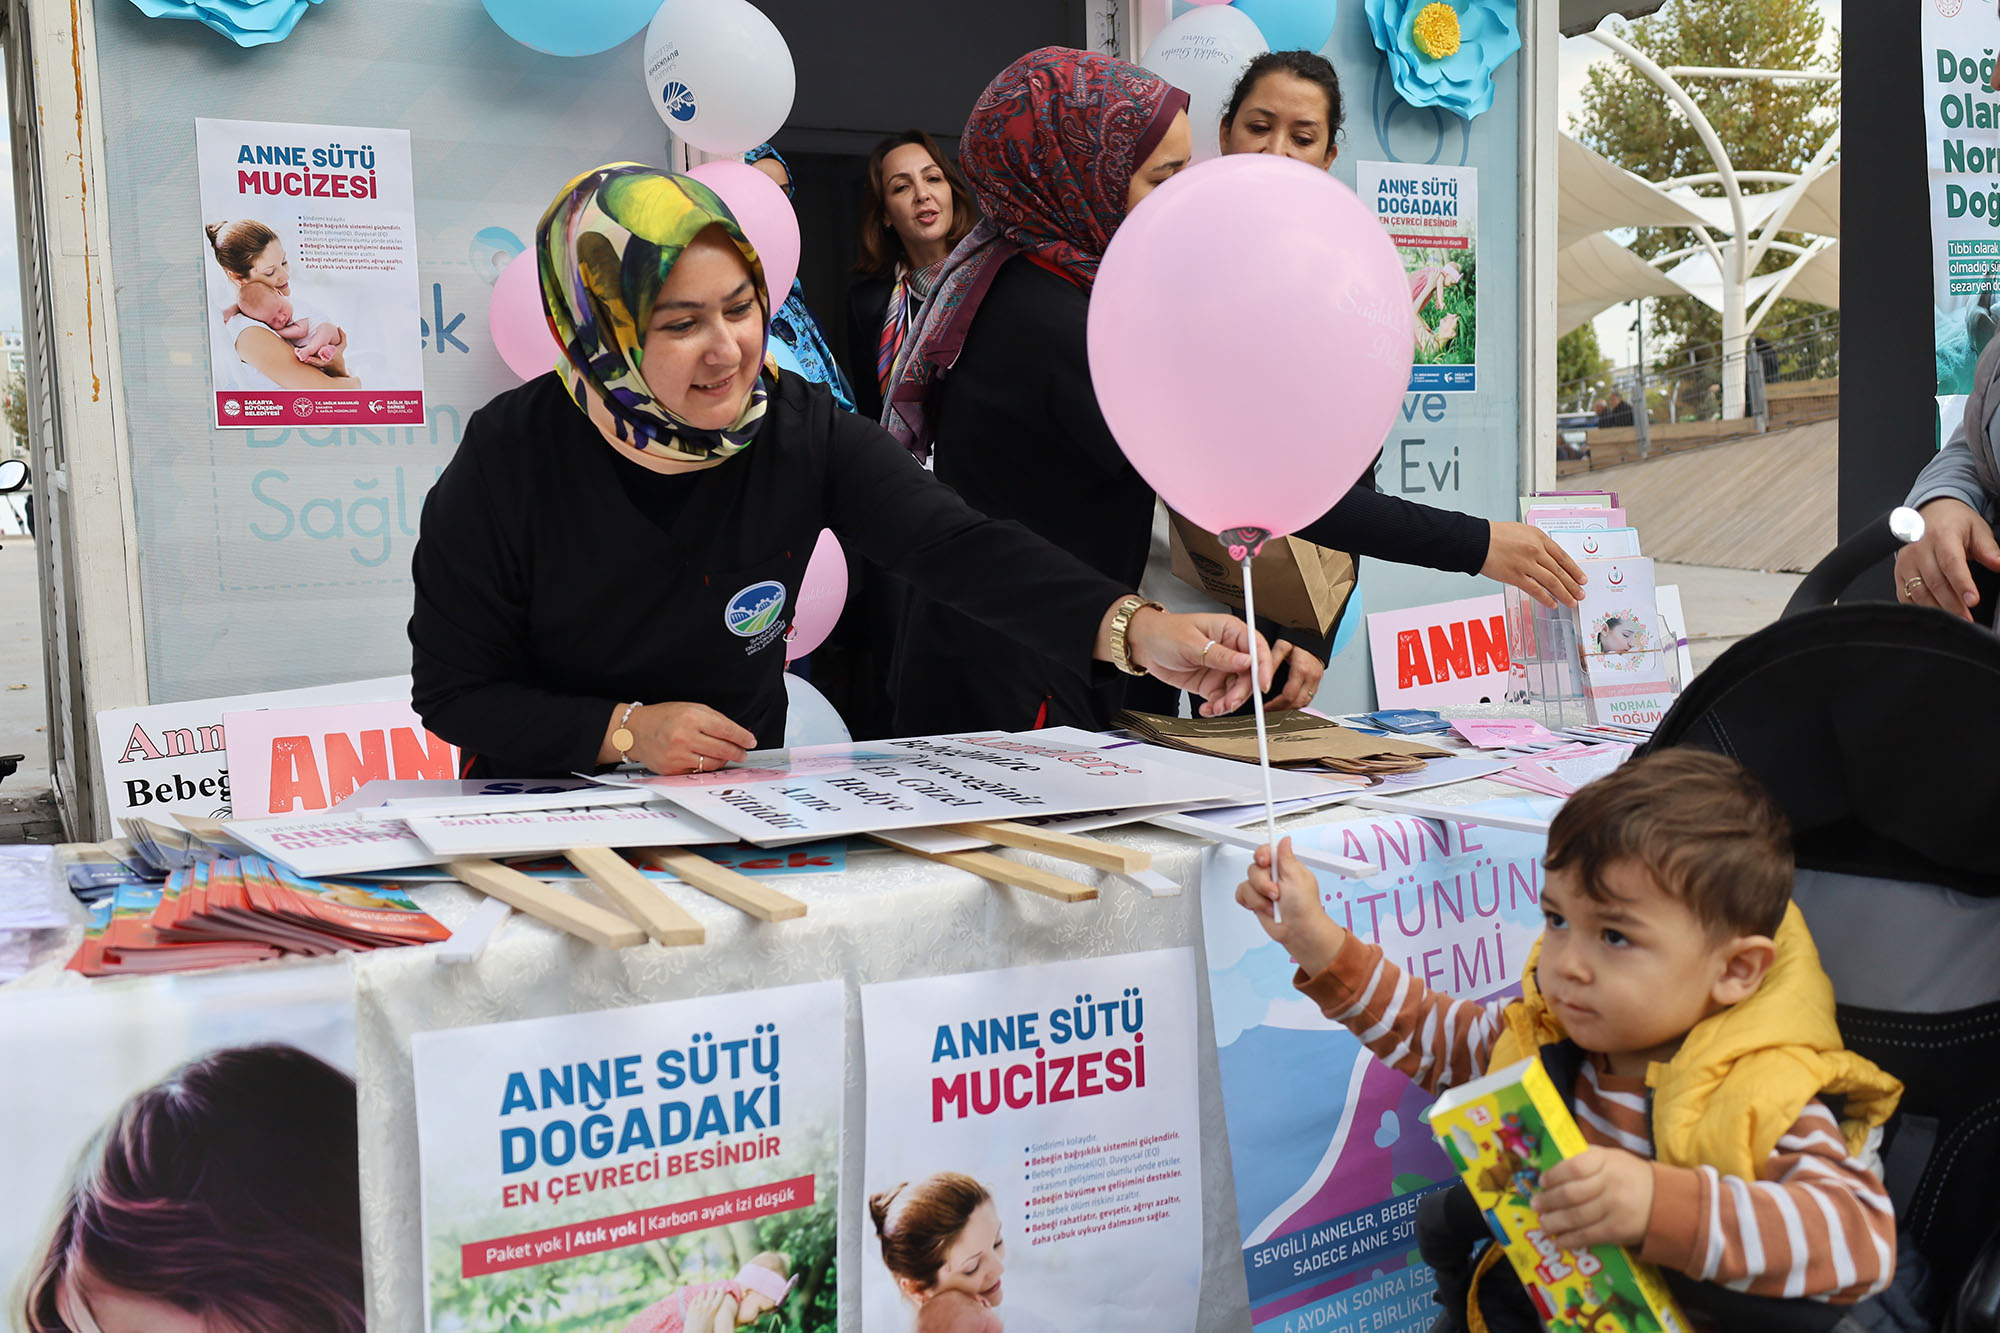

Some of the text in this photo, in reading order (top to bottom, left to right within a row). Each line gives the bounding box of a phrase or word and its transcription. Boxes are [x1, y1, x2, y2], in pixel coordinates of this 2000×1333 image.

[237, 143, 375, 169] ANNE SÜTÜ
[1943, 139, 2000, 174] Nor
[237, 166, 377, 199] MUCİZESİ
[1378, 177, 1457, 197] ANNE SÜTÜ
[1377, 192, 1457, 217] DOĞADAKİ
[1390, 216, 1422, 227] ÇEVRECİ
[1423, 216, 1458, 228] BESİNDİR
[1949, 242, 1999, 254] Tıbbi olarak
[1950, 261, 1990, 275] olmadığı
[1950, 281, 1992, 294] sezaryen
[1401, 393, 1447, 423] ve
[1400, 438, 1460, 494] Evi
[1397, 615, 1510, 690] ANN
[1610, 699, 1661, 713] NORMAL
[1612, 710, 1663, 725] DOĞUM
[770, 786, 842, 813] Anne
[823, 777, 914, 812] Hediye
[860, 765, 984, 807] En Güzel
[271, 825, 368, 842] ANNE
[439, 815, 539, 828] SADECE
[545, 812, 609, 823] ANNE
[1342, 817, 1484, 871] ANNE
[931, 986, 1144, 1064] ANNE SÜTÜ
[499, 1022, 780, 1117] ANNE SÜTÜ
[931, 1031, 1146, 1123] MUCİZESİ
[500, 1070, 781, 1175] DOĞADAKİ
[1031, 1138, 1065, 1153] Sindirimi
[1031, 1130, 1180, 1166] Bebeğin bağışıklık sistemini güçlendirir.
[502, 1132, 781, 1209] EN ÇEVRECİ BESİNDİR
[1031, 1167, 1062, 1181] Bebeğin
[1109, 1151, 1143, 1166] Duygusal
[1069, 1170, 1105, 1188] gelişimini
[1134, 1158, 1156, 1174] yönde
[1031, 1193, 1063, 1207] Bebeğin
[1064, 1185, 1096, 1200] büyüme
[1097, 1184, 1106, 1193] ve
[1107, 1175, 1145, 1192] gelişimini
[486, 1187, 795, 1264] Paket yok Atık yok Karbon ayak izi düşük
[1031, 1209, 1045, 1219] Ani
[1046, 1205, 1068, 1216] bebek
[1070, 1199, 1090, 1211] ölüm
[1031, 1220, 1058, 1234] Bebeği
[1099, 1205, 1132, 1221] gevşetir,
[1133, 1200, 1154, 1214] ağrıyı
[1031, 1210, 1171, 1246] daha çabuk uykuya dalmasını sağlar.
[1253, 1234, 1308, 1269] SEVGİLİ
[1310, 1213, 1379, 1249] ANNELER,
[1293, 1244, 1349, 1277] SADECE
[1351, 1230, 1389, 1257] ANNE
[1525, 1230, 1573, 1284] Play
[1297, 1297, 1349, 1333] AYDAN
[1352, 1277, 1406, 1311] SONRA
[1408, 1266, 1434, 1289] İSE
